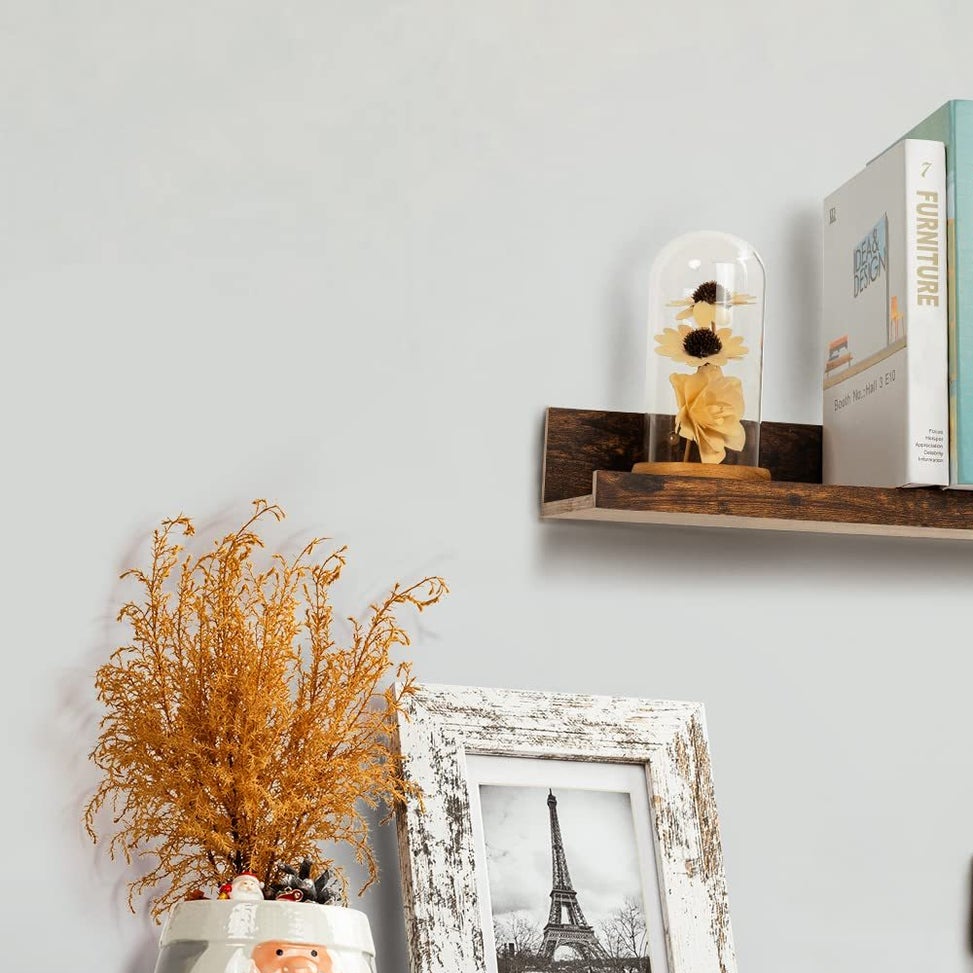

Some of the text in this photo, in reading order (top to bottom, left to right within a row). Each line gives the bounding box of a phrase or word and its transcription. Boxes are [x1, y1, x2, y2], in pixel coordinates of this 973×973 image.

[916, 190, 939, 308] FURNITURE
[853, 253, 887, 299] DESIGN
[834, 393, 851, 412] Booth
